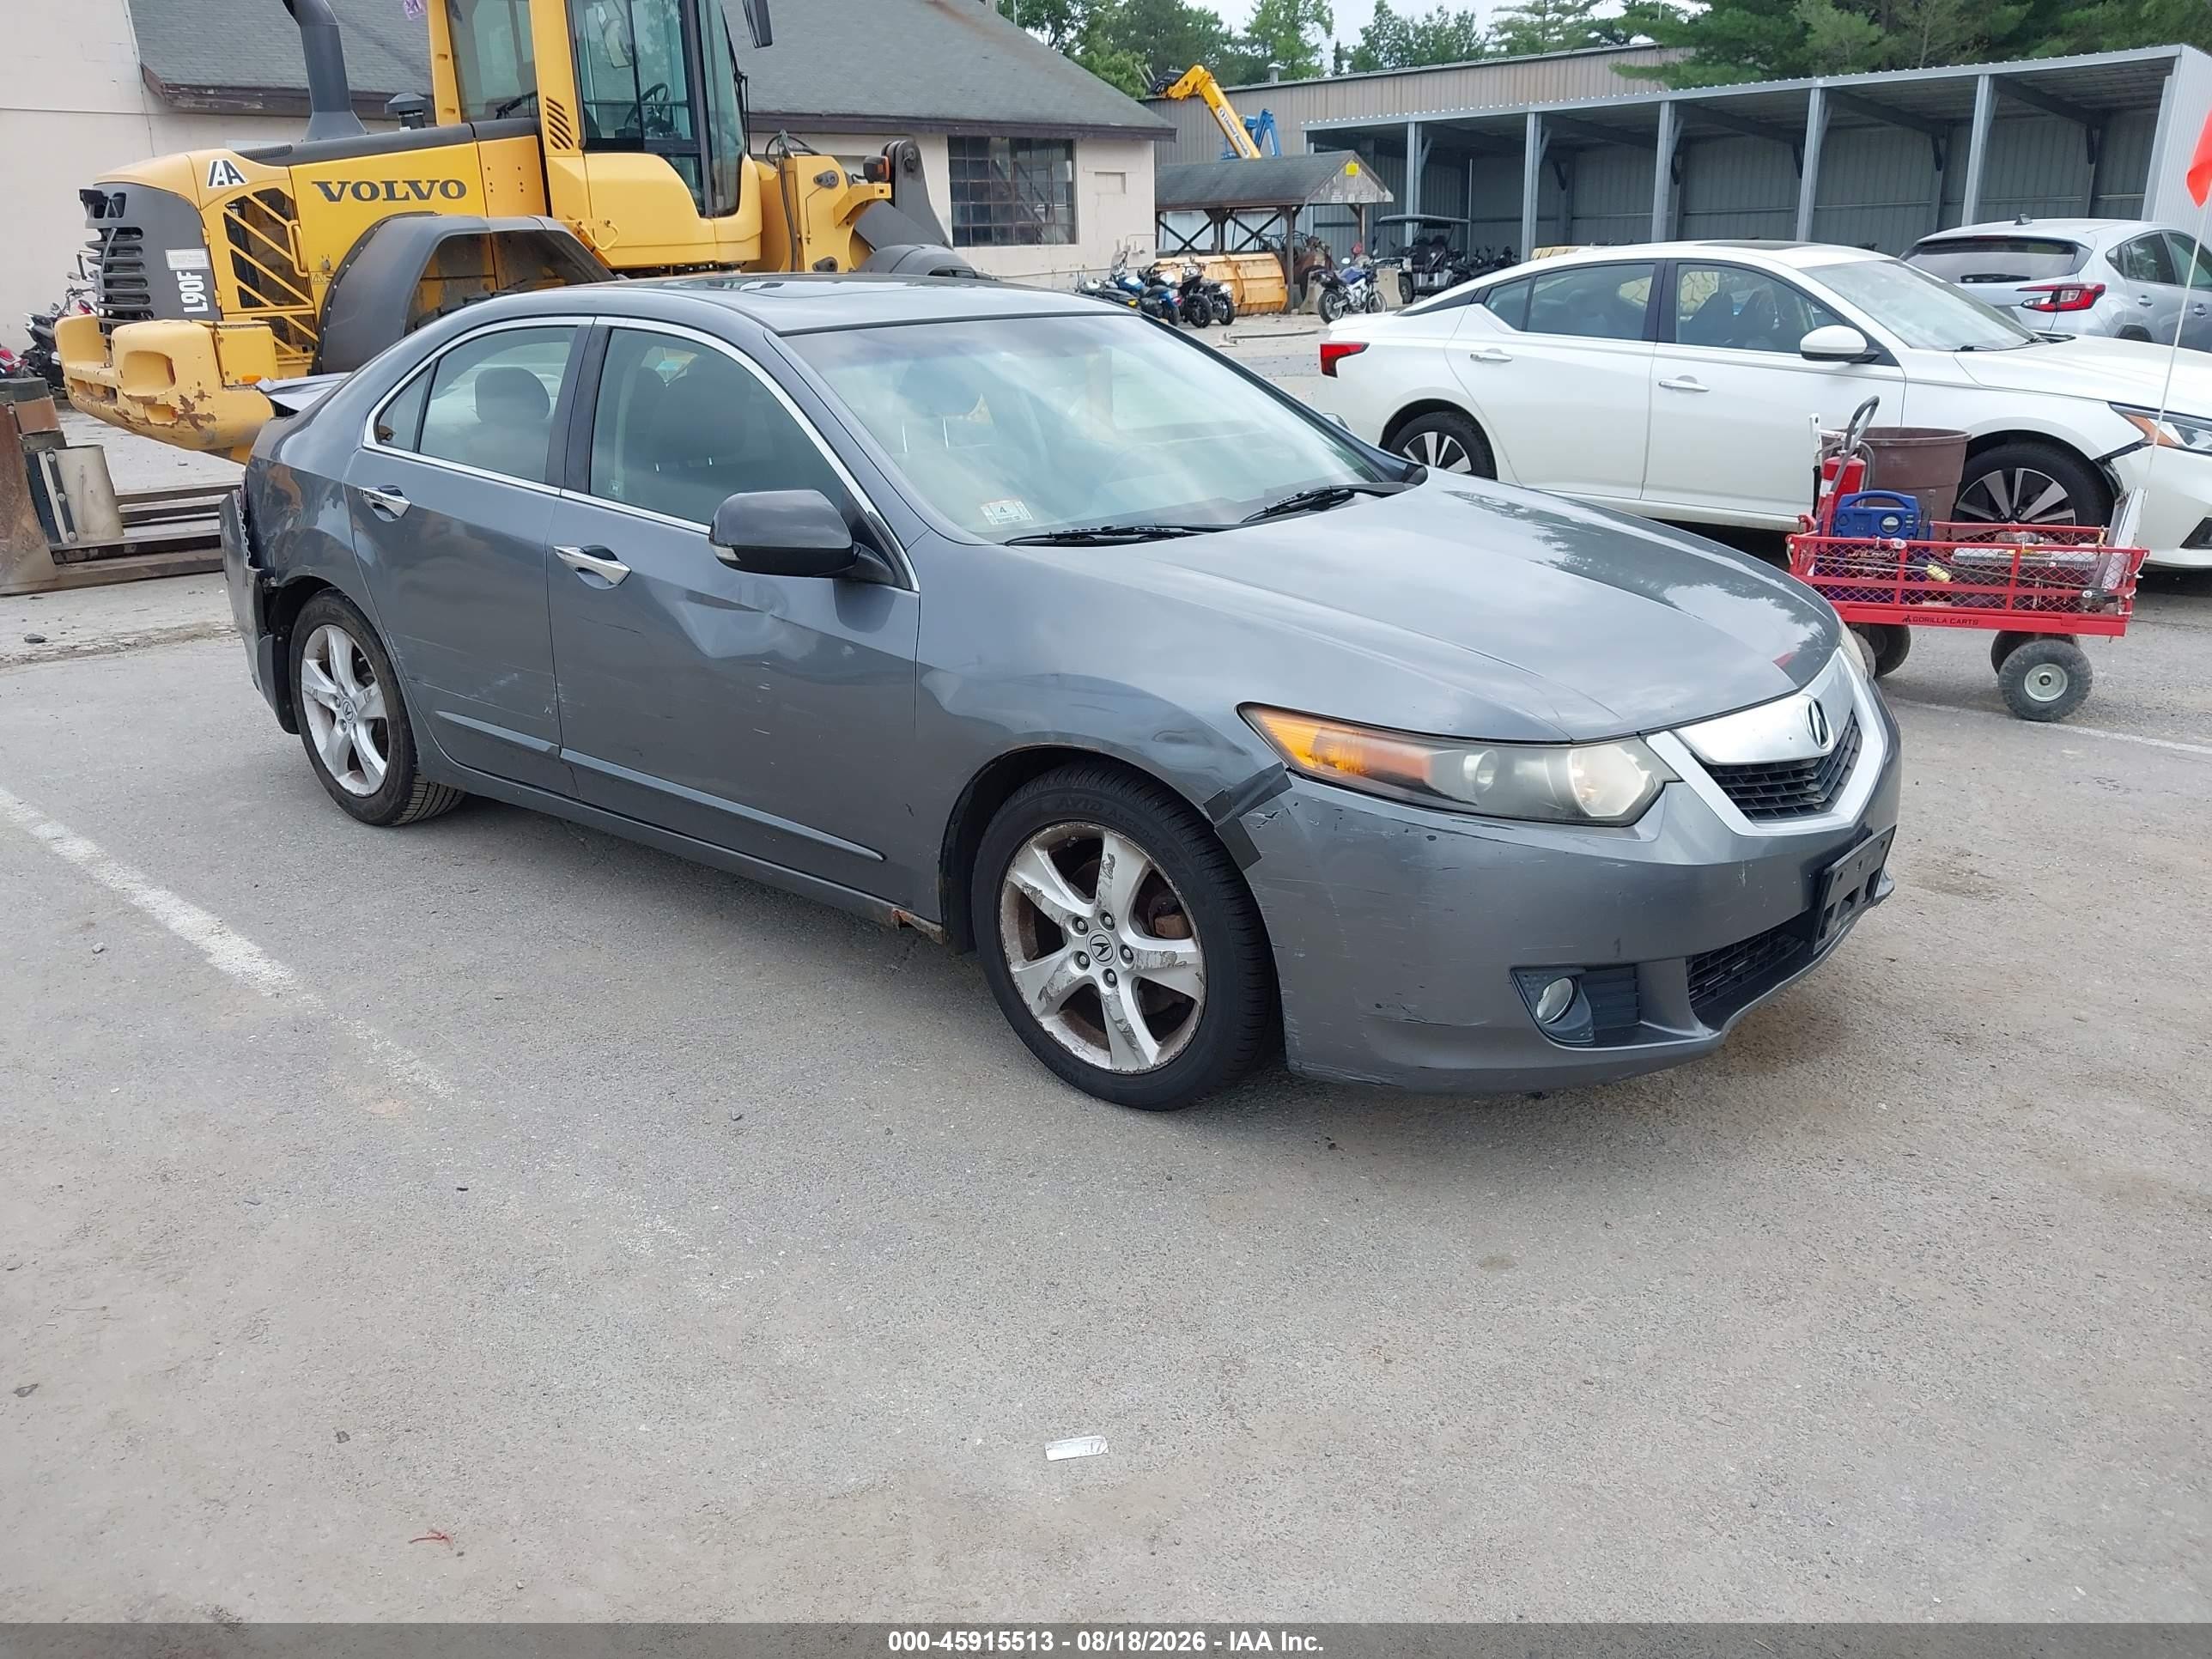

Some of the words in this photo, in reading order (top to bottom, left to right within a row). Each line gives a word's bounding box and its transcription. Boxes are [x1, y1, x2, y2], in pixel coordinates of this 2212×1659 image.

[207, 159, 246, 187] IAA
[311, 179, 467, 203] VOLVO
[176, 270, 209, 313] L90F
[1912, 616, 1948, 624] GORILLA
[1949, 617, 1979, 626] CARTS
[1056, 795, 1104, 812] AVID
